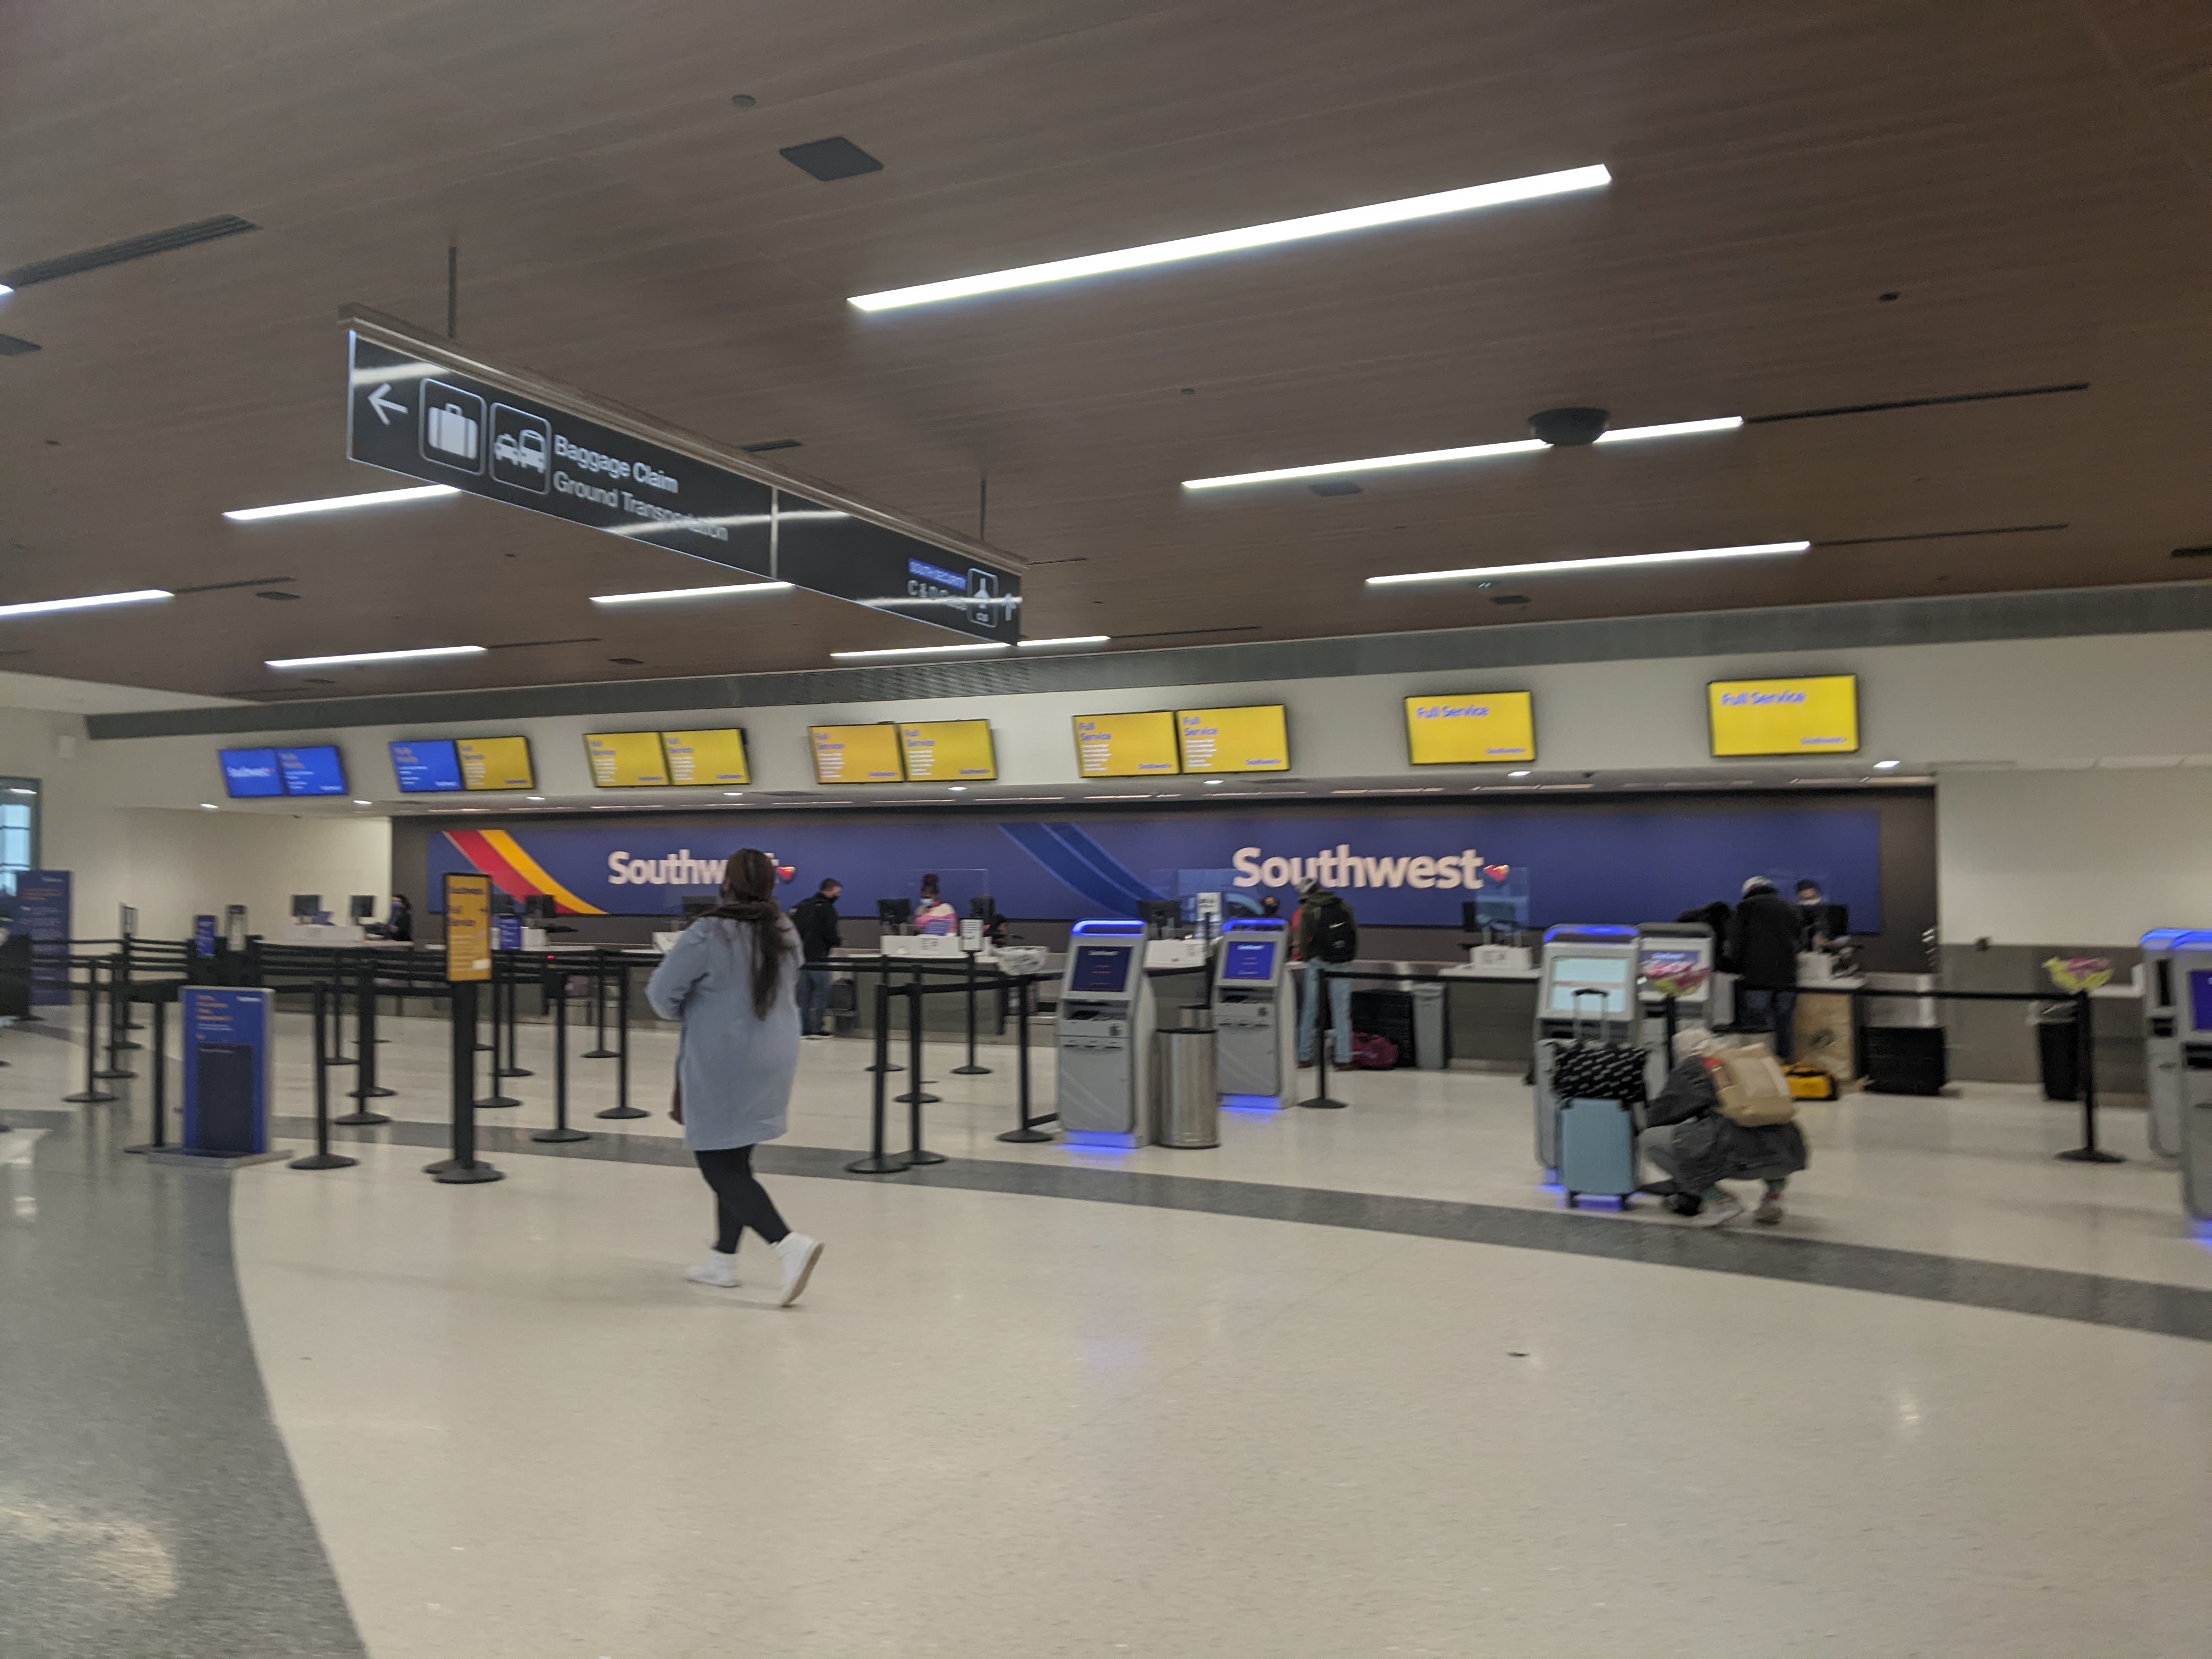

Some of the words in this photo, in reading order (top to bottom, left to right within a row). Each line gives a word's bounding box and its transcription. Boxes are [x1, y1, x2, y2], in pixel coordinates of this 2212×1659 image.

[554, 434, 630, 479] Baggage
[633, 462, 679, 494] Claim
[553, 470, 618, 507] Ground
[1417, 706, 1440, 718] Full
[1442, 704, 1489, 718] Service
[1722, 692, 1748, 706] Full
[1751, 689, 1807, 704] Service
[608, 849, 779, 884] Southw
[1233, 844, 1485, 889] Southwest
